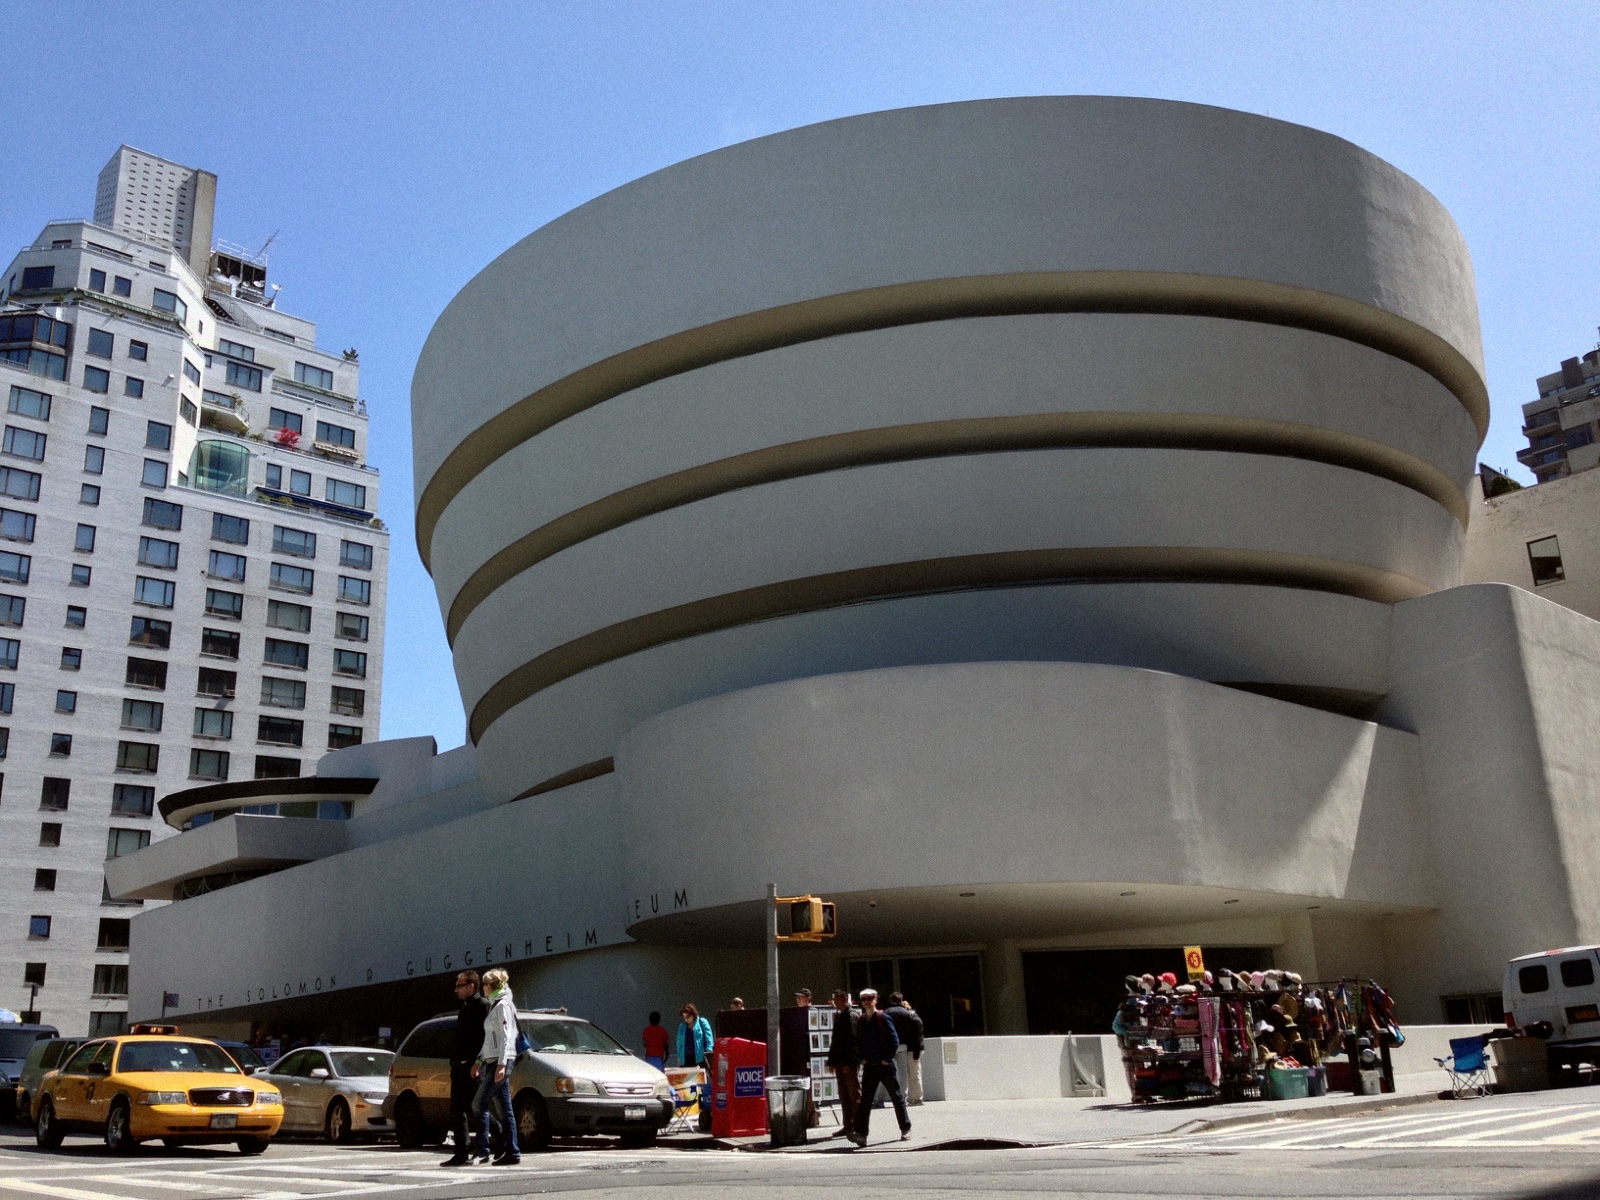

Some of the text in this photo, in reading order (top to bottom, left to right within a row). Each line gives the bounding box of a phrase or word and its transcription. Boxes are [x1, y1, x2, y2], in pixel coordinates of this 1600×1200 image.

[197, 994, 223, 1011] THE
[247, 975, 337, 1003] SOLOMON
[406, 928, 597, 976] GUGGENHEIM
[737, 1070, 763, 1083] VOICE
